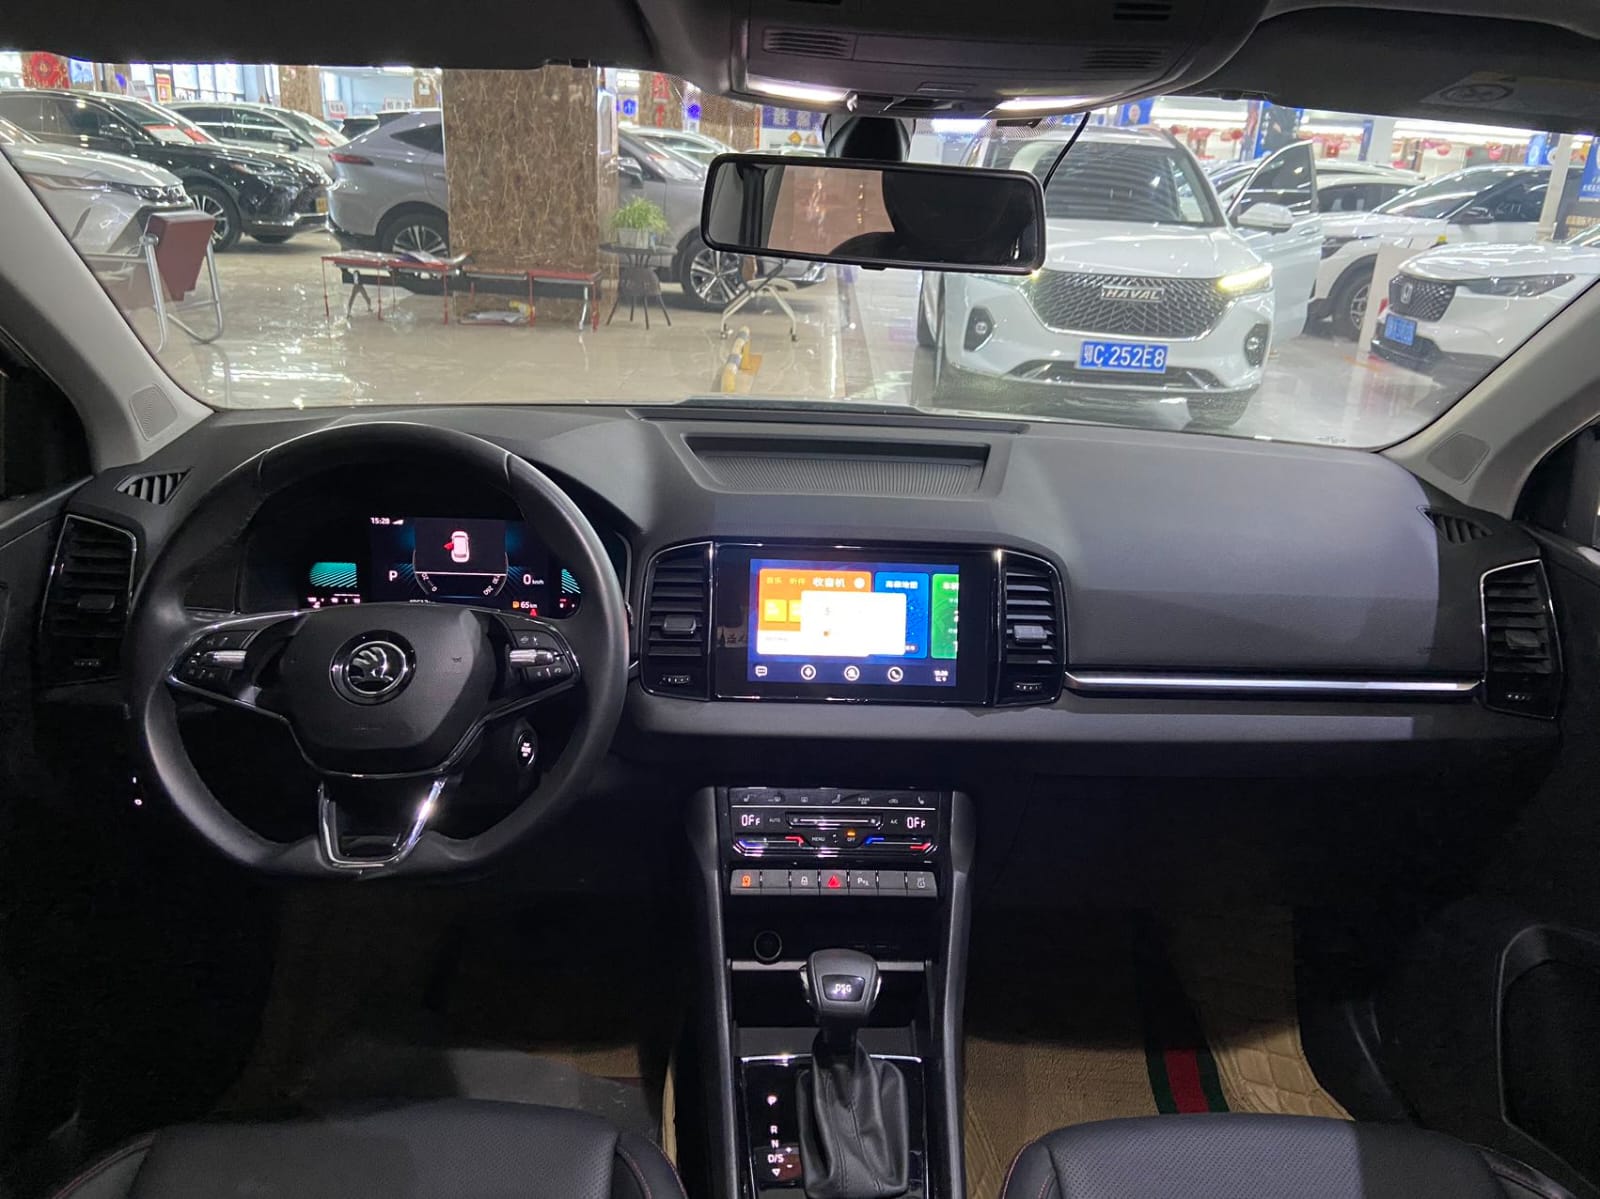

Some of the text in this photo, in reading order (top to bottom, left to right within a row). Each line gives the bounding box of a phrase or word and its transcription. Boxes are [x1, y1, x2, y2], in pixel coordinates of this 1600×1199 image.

[1105, 288, 1160, 300] HAVAL
[388, 570, 398, 581] P
[523, 574, 531, 585] 0
[520, 601, 530, 609] 65
[770, 1125, 778, 1134] R
[771, 1139, 779, 1149] N
[767, 1153, 785, 1164] D/S
